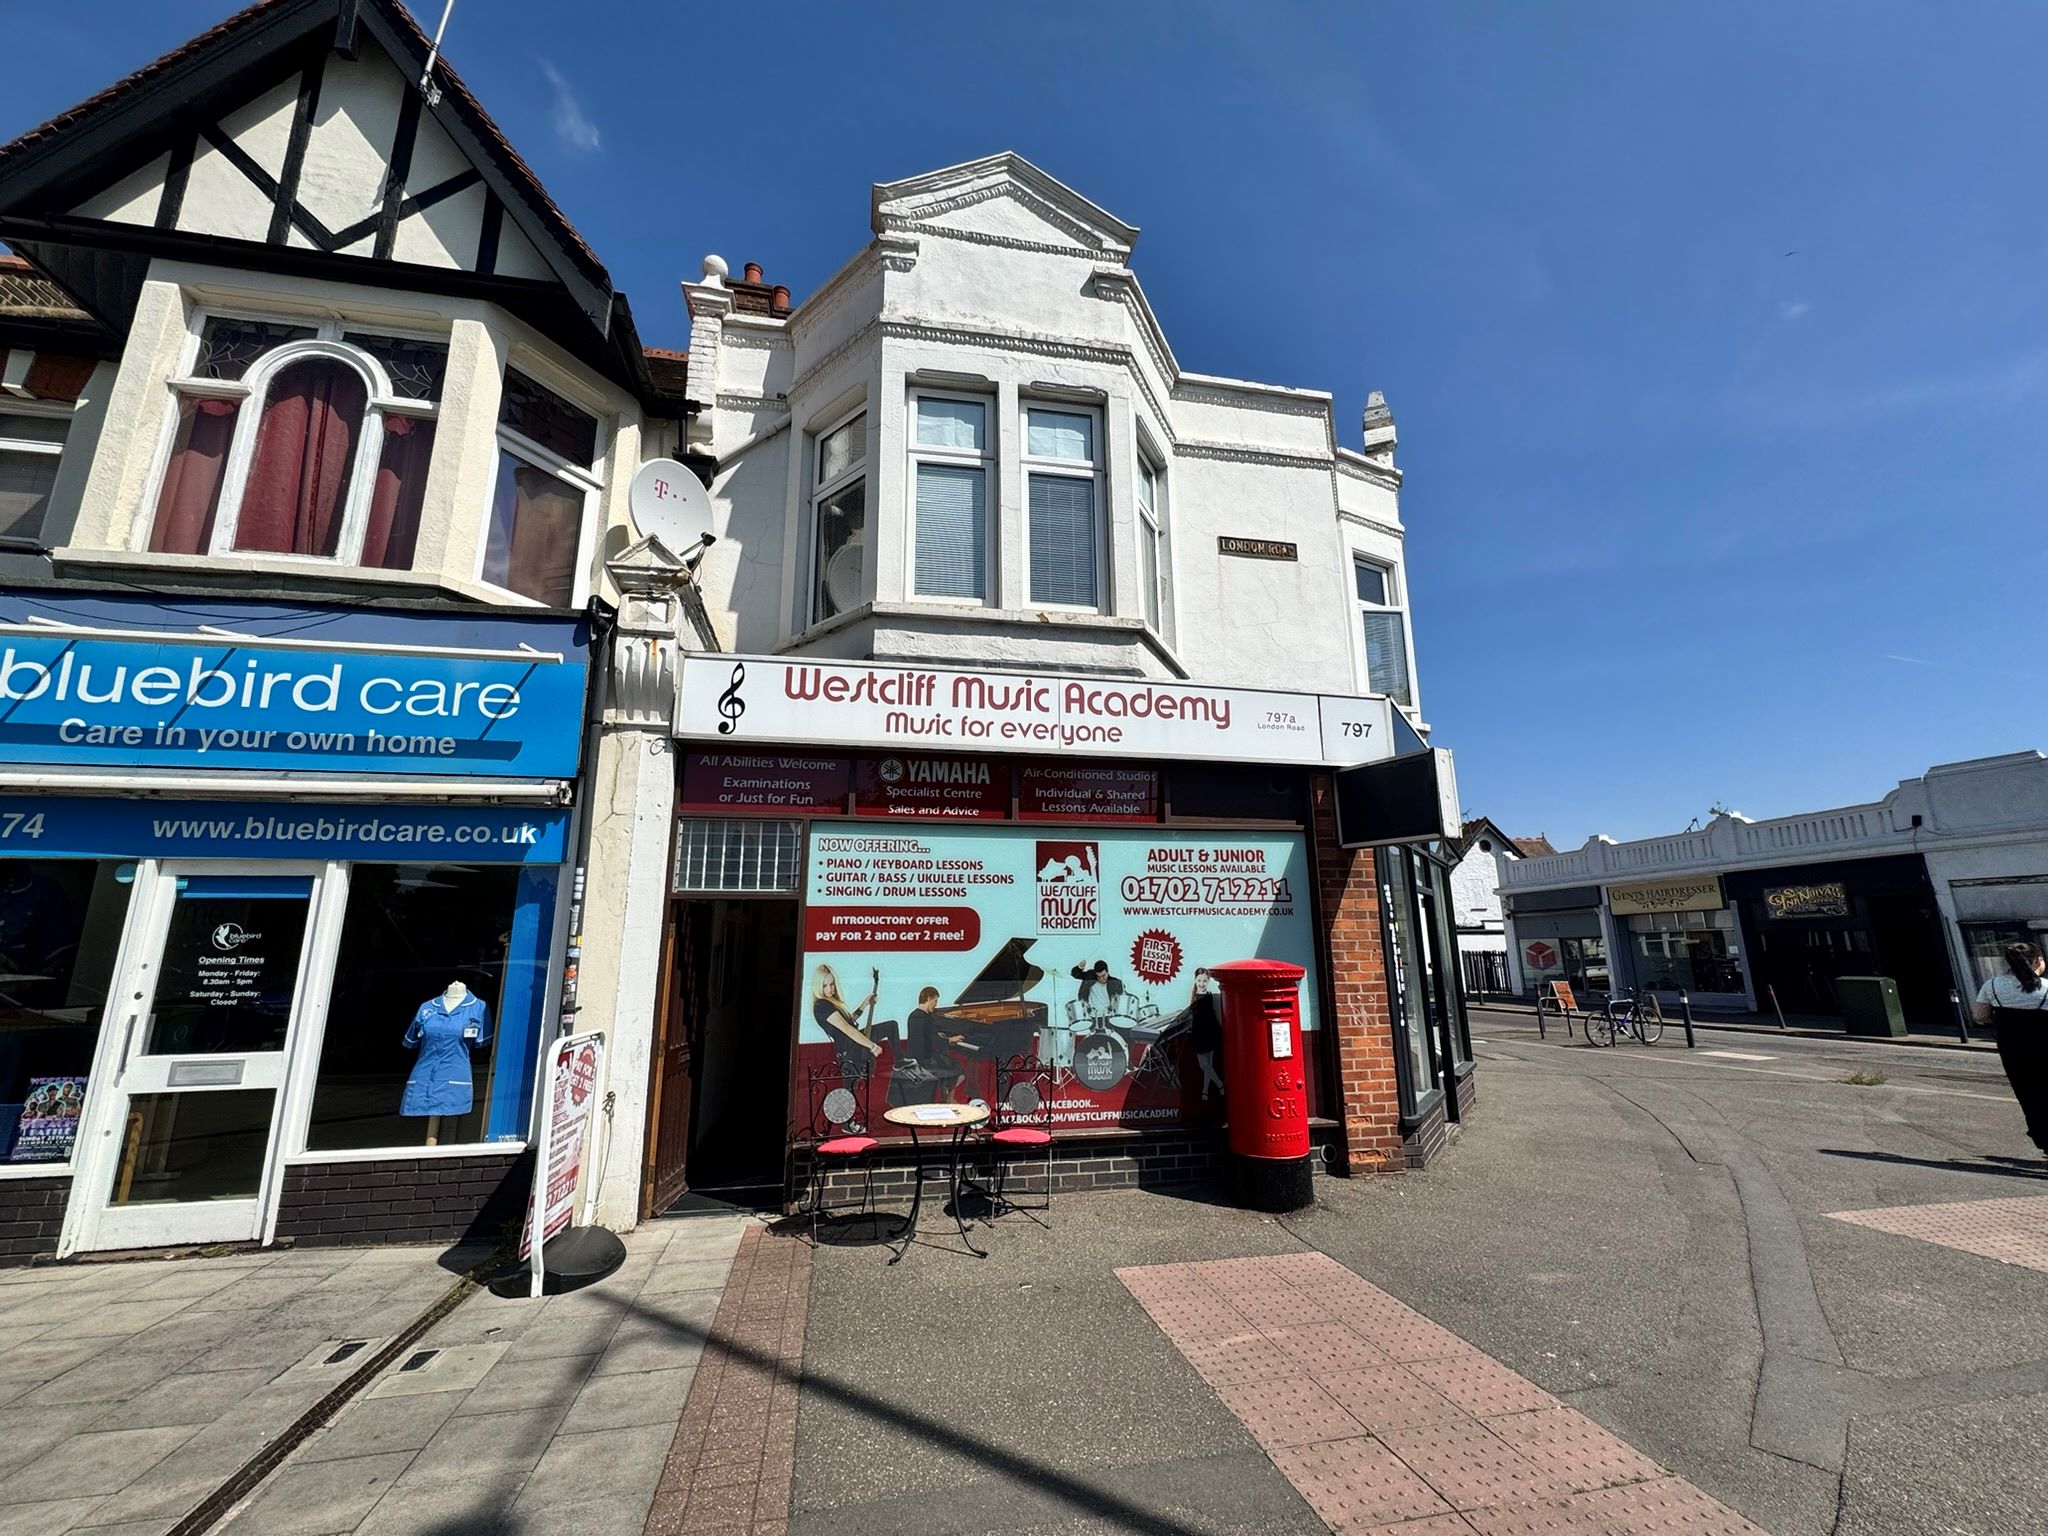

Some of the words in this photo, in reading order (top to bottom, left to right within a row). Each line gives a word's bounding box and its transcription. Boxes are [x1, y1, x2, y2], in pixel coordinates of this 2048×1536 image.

[1222, 539, 1266, 552] LONDON
[1268, 544, 1296, 557] ROAD
[0, 647, 342, 713] bluebird
[359, 676, 521, 719] care
[785, 666, 937, 707] Westcliff
[952, 675, 1050, 712] Music
[1064, 682, 1231, 729] Academy
[1265, 712, 1297, 724] 797a
[885, 711, 953, 736] Music
[960, 714, 995, 738] for
[1001, 721, 1123, 746] everyone
[1257, 722, 1284, 732] London
[1286, 724, 1306, 732] Road
[1341, 721, 1374, 738] 797
[59, 717, 143, 744] Care
[154, 720, 186, 746] in
[198, 725, 278, 753] your
[286, 731, 355, 752] own
[367, 728, 457, 755] home
[700, 755, 720, 766] All
[722, 755, 776, 769] Abilities
[778, 757, 837, 771] Welcome
[907, 760, 992, 785] YAMAHA
[1022, 767, 1114, 782] Air-Conditioned
[1116, 769, 1158, 782] Studios
[723, 777, 812, 790] Examinations
[719, 793, 735, 804] or
[736, 791, 764, 805] Just
[767, 792, 788, 804] for
[790, 794, 814, 805] Fun
[886, 785, 941, 799] Specialist
[941, 787, 984, 799] Centre
[1034, 787, 1092, 799] Individual
[1095, 789, 1104, 800] &
[1106, 788, 1147, 801] Shared
[888, 804, 916, 815] Sales
[918, 805, 940, 815] and
[942, 805, 981, 816] Advice
[1041, 802, 1087, 814] Lessons
[1089, 802, 1141, 816] Available
[1, 813, 45, 839] 74
[152, 816, 538, 846] www.bluebirdcare.co.uk
[818, 838, 855, 852] NOW
[854, 840, 931, 853] OFFERING...
[1147, 848, 1194, 863] ADULT
[1198, 849, 1210, 863] &
[1213, 849, 1266, 863] JUNIOR
[826, 859, 862, 869] PIANO
[873, 859, 933, 870] KEYBOARD
[935, 860, 984, 871] LESSONS
[1147, 864, 1177, 873] MUSIC
[1178, 864, 1219, 873] LESSONS
[1220, 865, 1267, 874] AVAILABLE
[826, 872, 868, 883] GUITAR
[878, 873, 907, 884] BASS
[917, 873, 965, 884] UKULELE
[967, 874, 1015, 885] LESSONS
[825, 886, 872, 897] SINGING
[883, 887, 917, 897] DRUM
[918, 887, 968, 898] LESSONS
[1040, 885, 1097, 897] WESTCLIFF
[1121, 876, 1200, 904] 01702
[1201, 877, 1293, 904] 712211
[1612, 890, 1646, 900] GENTS
[1646, 884, 1717, 898] HAIRDRESSER
[1040, 898, 1097, 917] MUSIC
[1123, 907, 1294, 916] WWW.WESTCLIFFMUSICACADEMY.CO.UK
[1040, 918, 1097, 930] ACADEMY
[840, 931, 862, 941] FOR
[864, 930, 872, 941] 2
[923, 930, 931, 941] 2
[1144, 939, 1172, 952] FIRST
[198, 956, 236, 965] Opening
[239, 956, 265, 964] Times
[1143, 950, 1171, 961] LESSON
[1141, 958, 1170, 974] FREE
[198, 970, 229, 978] Monday
[234, 970, 261, 978] Friday:
